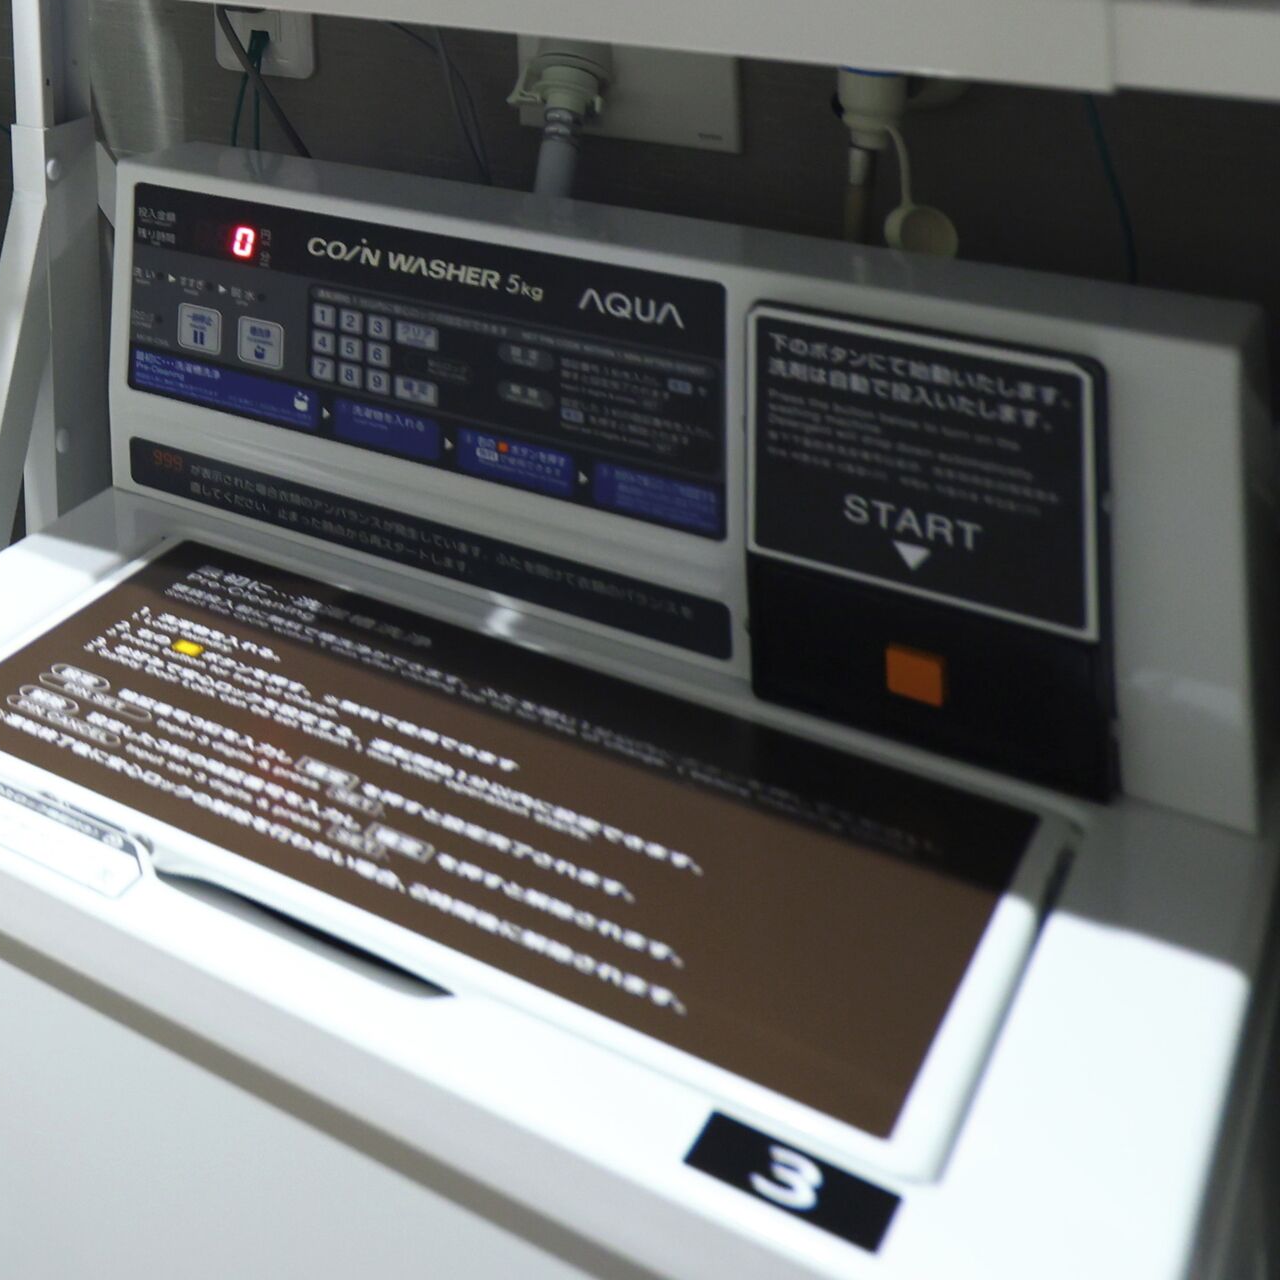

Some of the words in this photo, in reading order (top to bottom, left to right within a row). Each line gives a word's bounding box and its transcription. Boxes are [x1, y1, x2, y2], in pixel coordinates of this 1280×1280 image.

[137, 205, 177, 223] 投入金額
[137, 226, 177, 245] 残り時間
[231, 225, 256, 258] 0
[386, 252, 502, 291] WASHER
[504, 273, 545, 303] 5kg
[578, 287, 687, 330] AQUA
[400, 324, 433, 339] クリア
[767, 330, 1072, 411] 下のボタンにて始動いたします。
[767, 357, 1054, 434] 洗剤は自動で投入いたします。
[351, 405, 426, 434] 洗濯物を入れる
[151, 448, 184, 473] 999
[843, 492, 983, 552] START
[749, 1145, 825, 1212] 3
